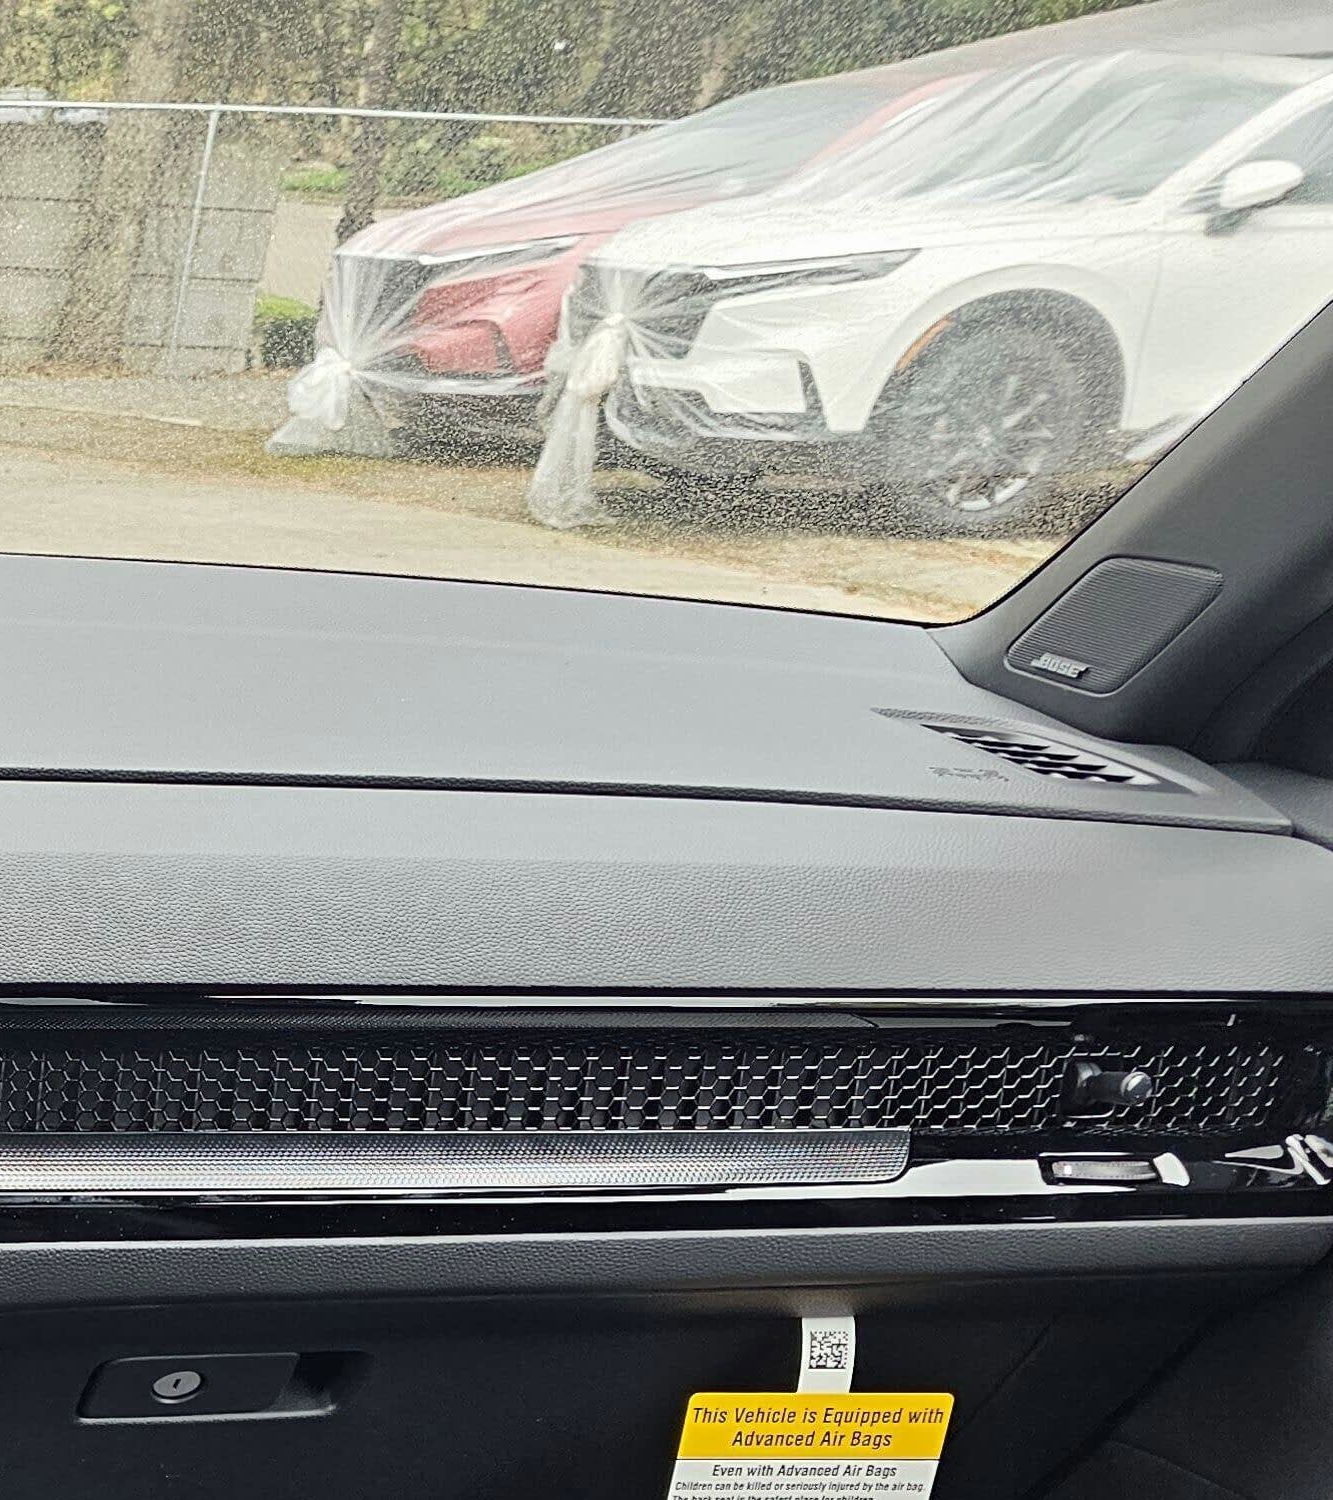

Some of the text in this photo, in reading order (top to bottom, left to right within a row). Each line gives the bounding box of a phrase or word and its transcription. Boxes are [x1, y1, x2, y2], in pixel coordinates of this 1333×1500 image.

[693, 1408, 944, 1427] This Vehicle is Equipped with
[732, 1430, 893, 1449] Advanced Air Bags
[712, 1465, 897, 1479] Even with Advanced Air Bags
[675, 1482, 712, 1490] Children
[733, 1482, 744, 1490] be
[746, 1482, 772, 1490] killed
[785, 1482, 827, 1492] seriously
[828, 1482, 860, 1492] injured
[862, 1482, 874, 1492] by
[875, 1482, 889, 1490] the
[891, 1482, 904, 1490] air
